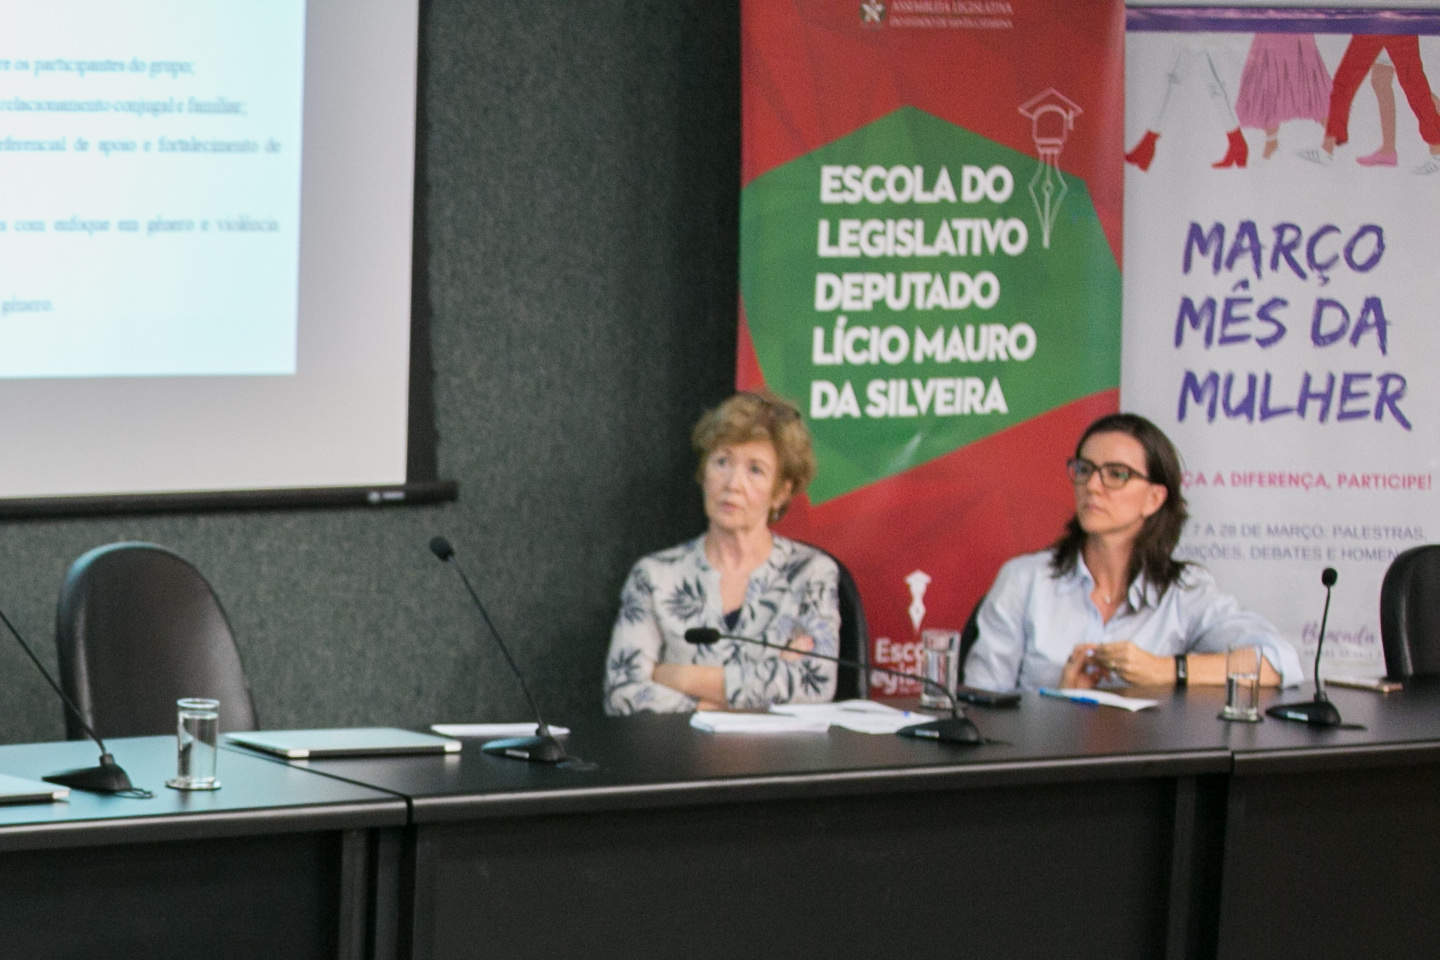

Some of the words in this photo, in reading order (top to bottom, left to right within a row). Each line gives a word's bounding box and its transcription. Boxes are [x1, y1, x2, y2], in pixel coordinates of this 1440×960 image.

[15, 60, 30, 72] os
[34, 57, 125, 77] participantes
[128, 56, 147, 72] do
[0, 97, 111, 114] relacionamento
[113, 96, 174, 118] conjugal
[176, 101, 184, 113] e
[73, 135, 90, 152] de
[98, 139, 137, 157] apoio
[143, 141, 152, 152] e
[157, 134, 260, 154] fortalecimento
[263, 136, 282, 153] de
[819, 165, 958, 203] ESCOLA
[961, 164, 1015, 203] DO
[14, 220, 46, 233] com
[54, 216, 110, 236] enfoque
[117, 220, 139, 233] em
[146, 216, 195, 237] gênero
[200, 220, 210, 233] e
[216, 215, 280, 234] violência
[817, 217, 1029, 257] LEGISLATIVO
[1182, 219, 1386, 287] MARÇO
[814, 271, 1001, 311] DEPUTADO
[1174, 278, 1289, 350] MÊS
[1310, 296, 1392, 357] DA
[812, 315, 910, 365] LÍCIO
[913, 322, 1038, 364] MAURO
[810, 379, 862, 419] DA
[864, 376, 1010, 418] SILVEIRA
[1177, 369, 1413, 432] MULHER
[1180, 471, 1207, 489] ÇA
[1213, 471, 1226, 487] A
[1230, 471, 1332, 492] DIFERENÇA,
[1336, 472, 1433, 491] PARTICIPE!
[1205, 523, 1217, 538] A
[1241, 523, 1260, 538] DE
[1250, 544, 1323, 561] DEBATES
[1327, 545, 1337, 560] E
